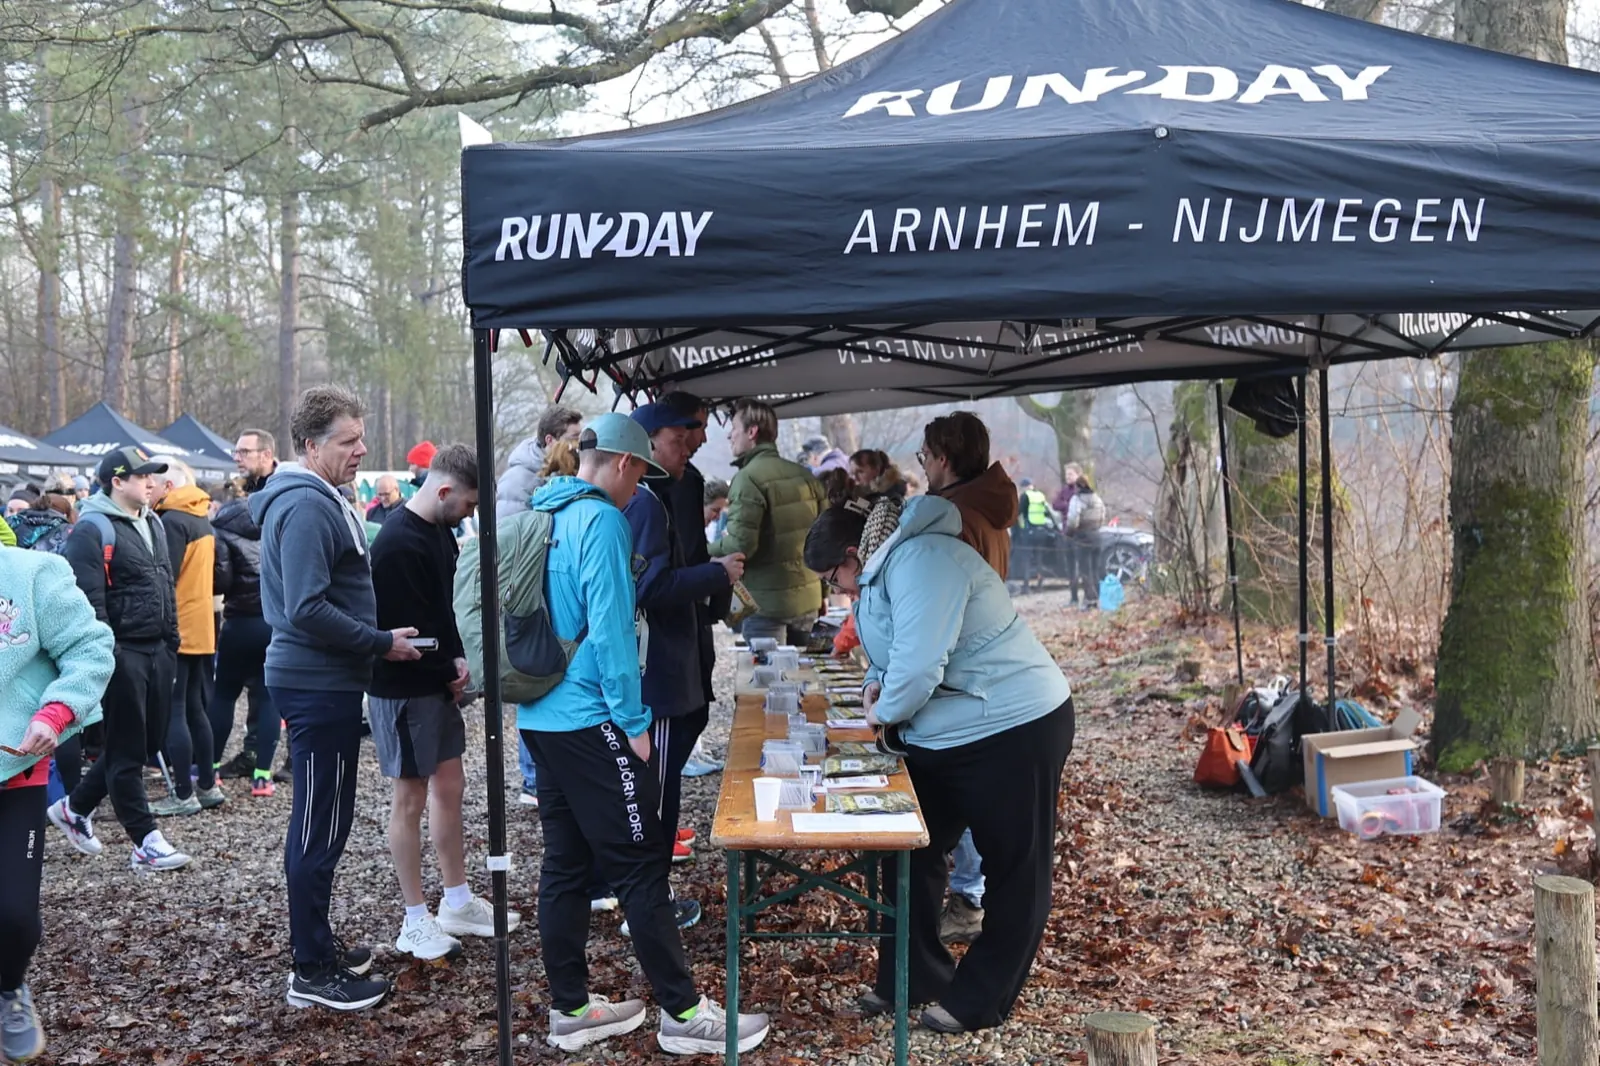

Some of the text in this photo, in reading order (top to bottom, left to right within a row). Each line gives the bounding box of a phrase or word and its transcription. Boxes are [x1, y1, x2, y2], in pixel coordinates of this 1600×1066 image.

[842, 65, 1391, 118] RUN2DAY
[494, 211, 713, 262] RUN2DAY
[844, 202, 1100, 254] ARNHEM
[1172, 198, 1485, 243] NIJMEGEN
[615, 756, 635, 801] BJÖRN
[626, 803, 644, 842] BORG
